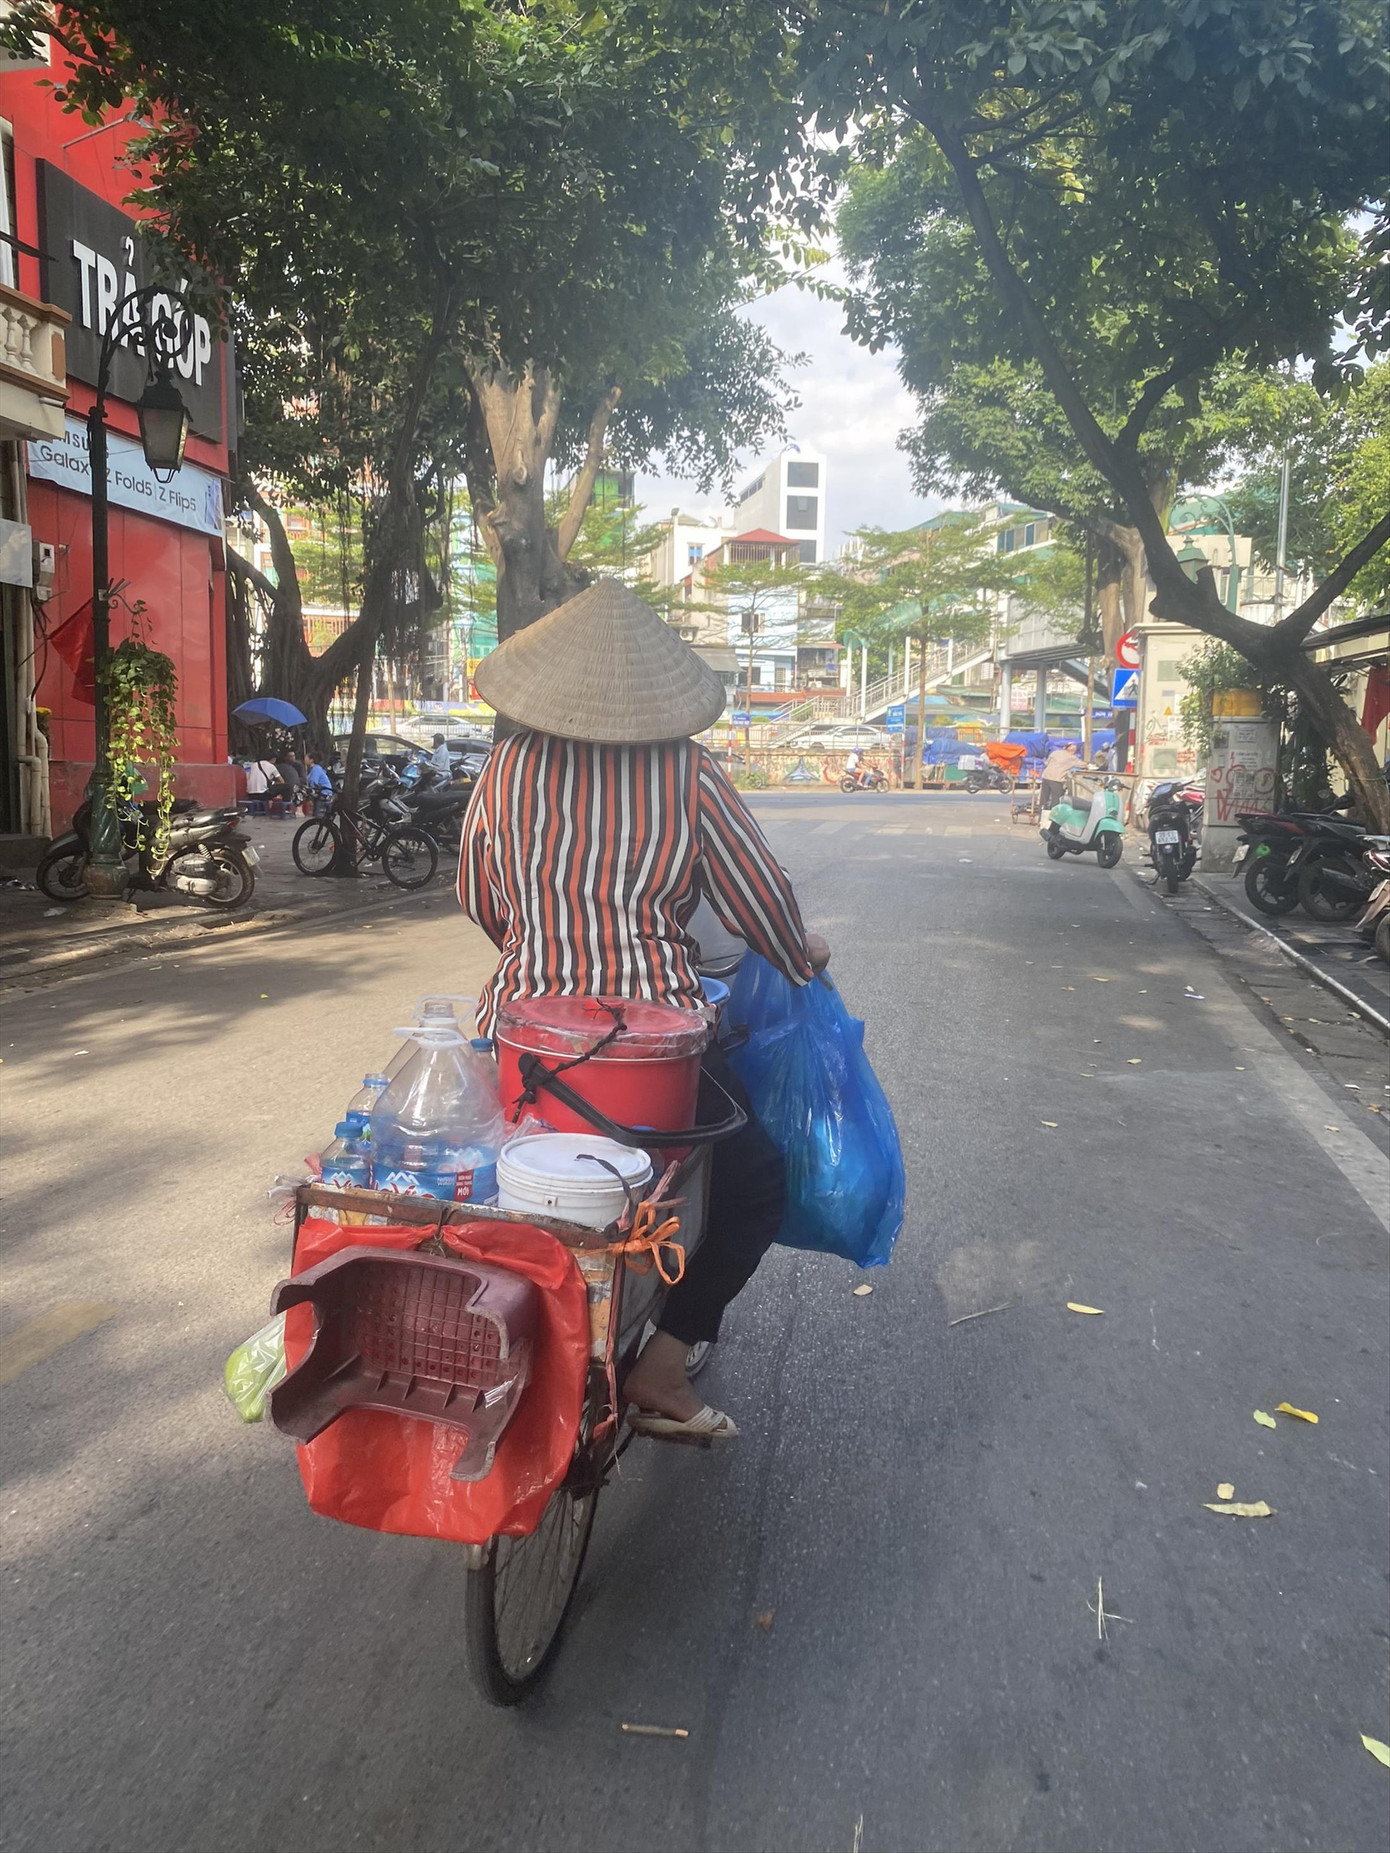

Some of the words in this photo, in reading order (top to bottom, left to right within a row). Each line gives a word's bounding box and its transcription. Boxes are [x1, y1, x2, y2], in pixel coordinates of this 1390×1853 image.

[73, 235, 146, 357] TRẢ
[40, 444, 90, 476] Galax
[115, 472, 153, 497] Fold5
[159, 486, 167, 502] Z
[169, 490, 197, 513] Flip5
